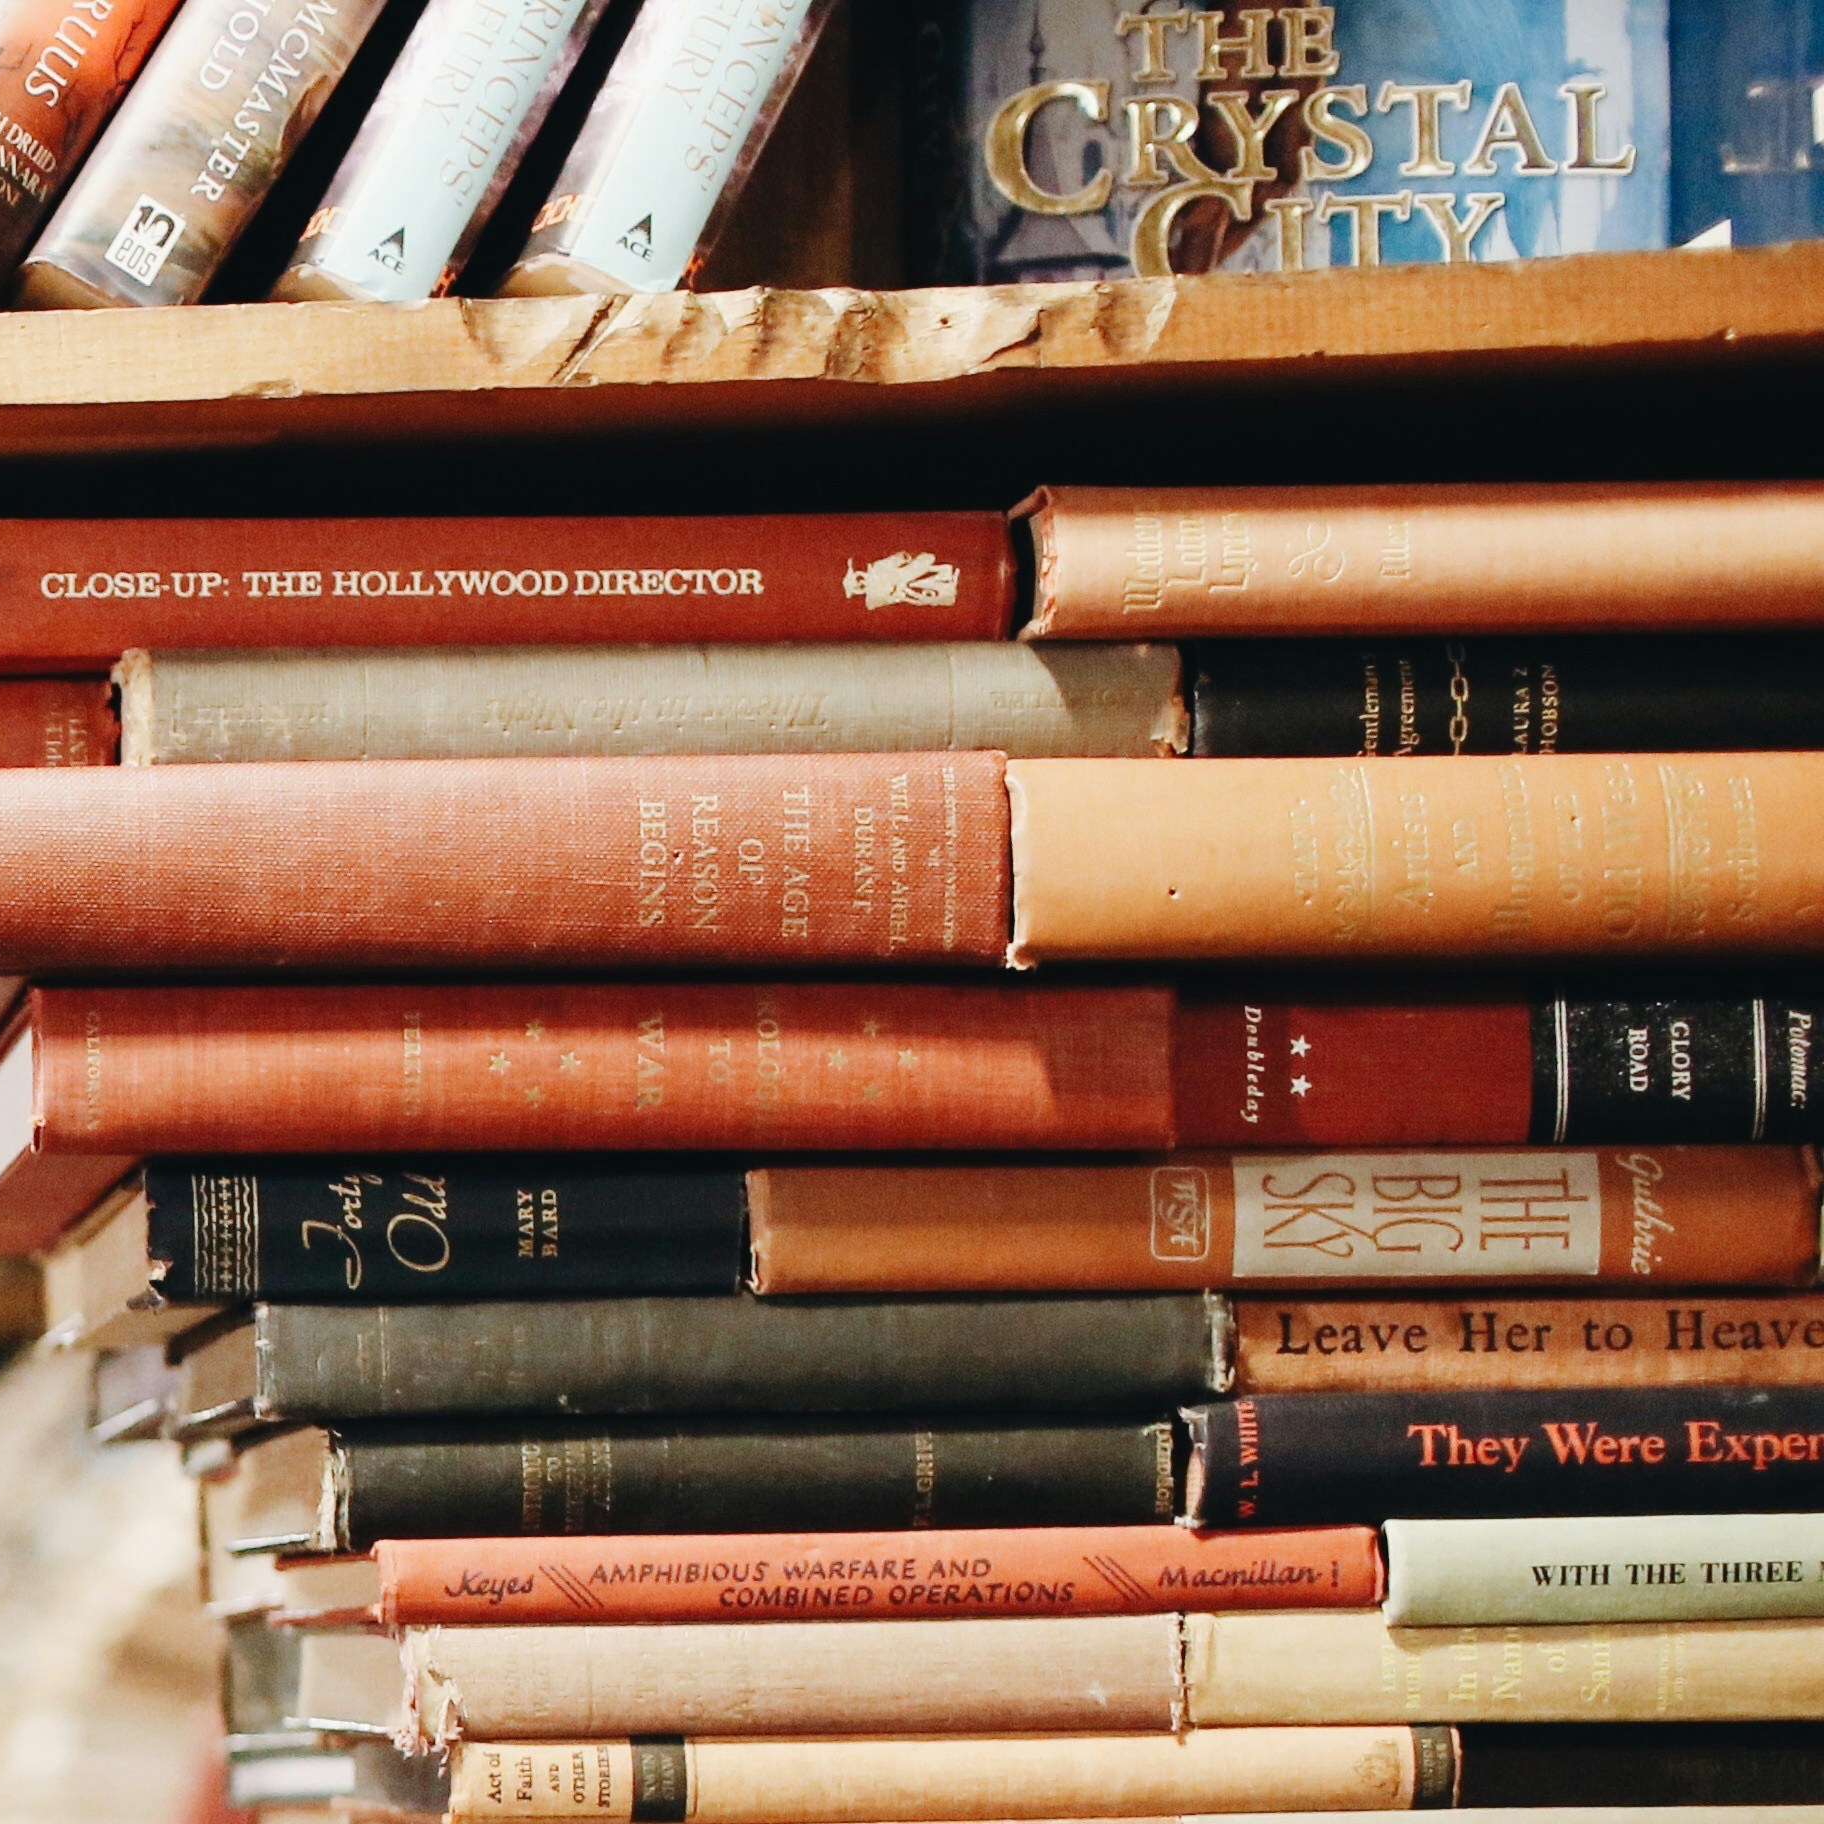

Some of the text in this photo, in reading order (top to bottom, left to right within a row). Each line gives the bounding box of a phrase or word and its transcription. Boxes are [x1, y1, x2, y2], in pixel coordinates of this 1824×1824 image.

[1115, 6, 1338, 82] THE
[985, 79, 1636, 217] CRYSTAL
[615, 232, 654, 261] ACE
[1131, 178, 1505, 280] CITY
[368, 247, 406, 277] ACE
[40, 566, 764, 600] CLOSE-UP: THE HOLLYWOOD DIRECTOR
[637, 800, 668, 930] BEGINS
[687, 792, 718, 934] REASON
[737, 836, 765, 890] OF
[1628, 1027, 1649, 1094] ROAD
[1671, 1020, 1693, 1101] GLORY
[517, 1188, 535, 1259] MARY
[539, 1188, 558, 1258] BARD
[1260, 1173, 1355, 1258] SKY
[1370, 1173, 1463, 1254] BIG
[1480, 1168, 1591, 1253] THE
[1615, 1153, 1677, 1275] Guthrie
[1276, 1312, 1429, 1355] Leave
[1458, 1311, 1553, 1354] Her
[1582, 1313, 1634, 1352] to
[1407, 1423, 1528, 1471] They
[1543, 1423, 1666, 1466] Were
[445, 1568, 535, 1606] Keyes
[588, 1557, 992, 1584] AMPHIBIOUS WARFARE AND
[719, 1579, 1076, 1609] COMBINED OPERATIONS
[1158, 1560, 1318, 1590] Macmillan
[1530, 1560, 1805, 1588] WITH THE THREE
[515, 1756, 534, 1802] Faith
[548, 1761, 561, 1795] AND
[572, 1751, 586, 1805] OTHER
[596, 1745, 612, 1809] STORIES
